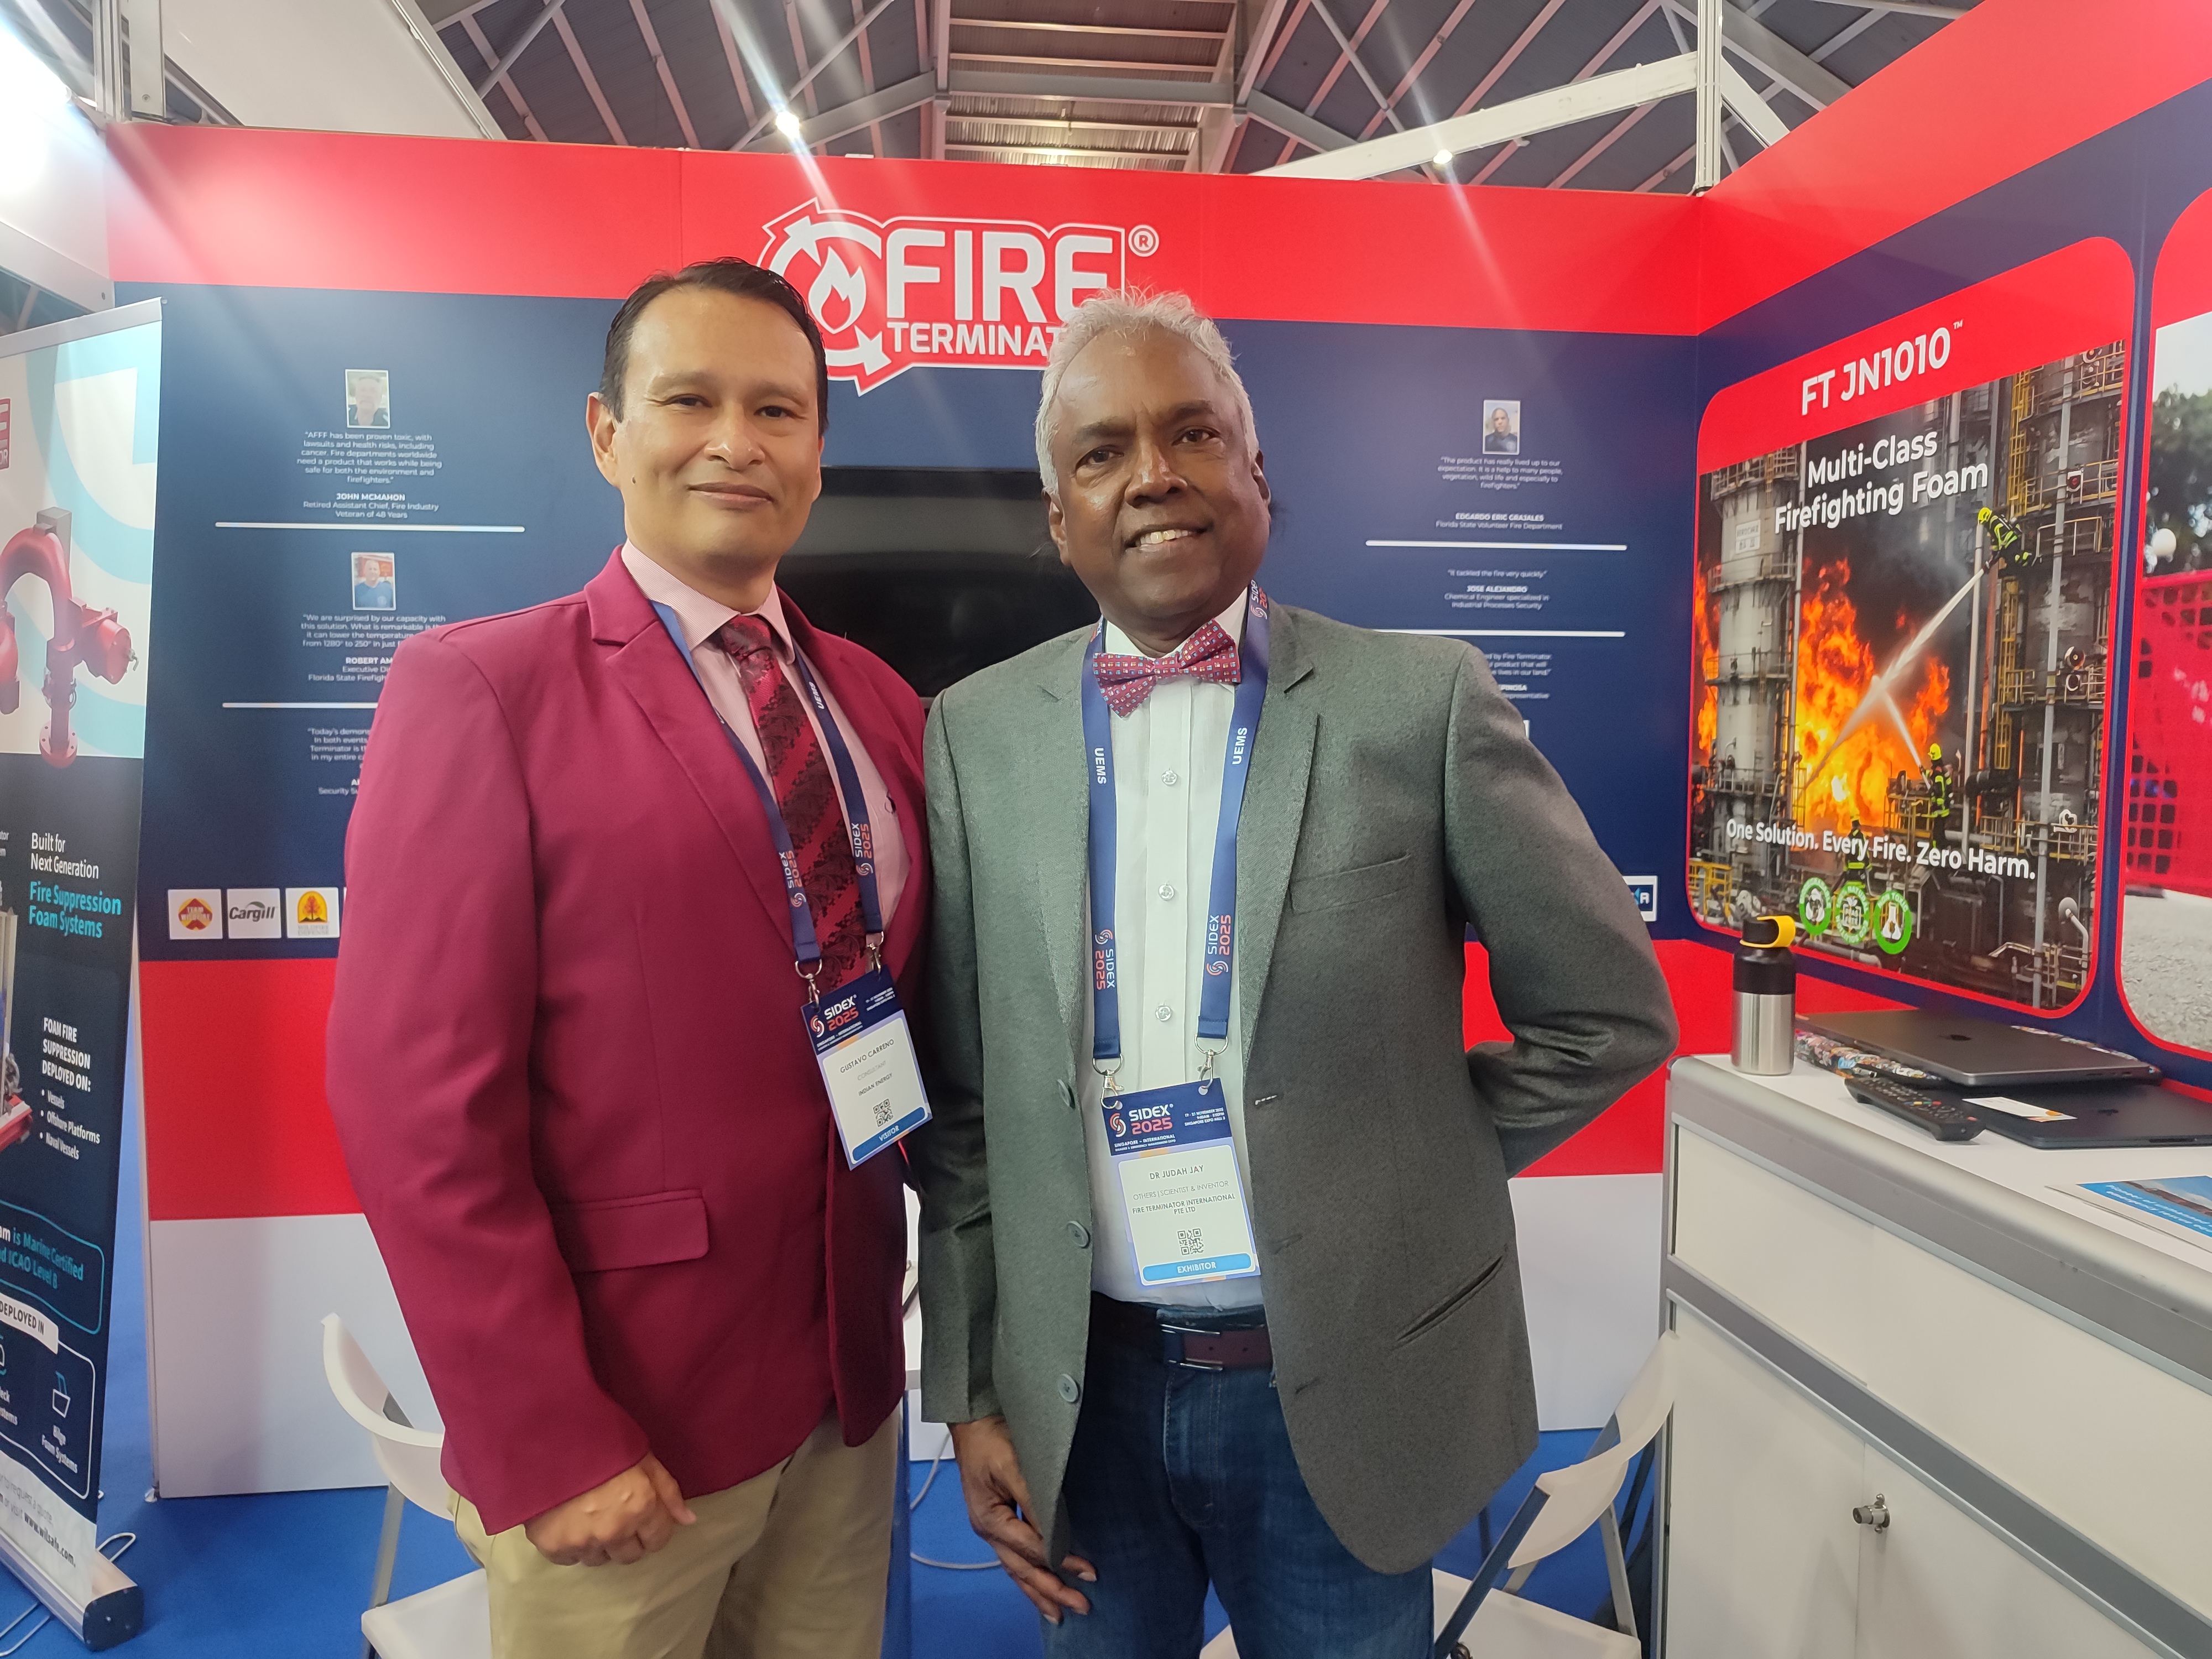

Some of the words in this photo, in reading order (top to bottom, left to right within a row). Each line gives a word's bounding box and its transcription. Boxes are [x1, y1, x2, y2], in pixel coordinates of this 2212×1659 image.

[886, 228, 1113, 322] FIRE
[1801, 369, 1836, 416] FT
[1840, 327, 1951, 402] JN1010
[399, 442, 434, 451] including
[1808, 430, 1938, 488] Multi-Class
[421, 460, 442, 469] being
[408, 503, 439, 512] Industry
[1774, 481, 1905, 534] Firefighting
[1912, 462, 1989, 504] Foam
[1476, 593, 1506, 602] Engineer
[1516, 602, 1543, 611] Security
[1232, 727, 1248, 765] UEMS
[1094, 748, 1107, 784] UEMS
[319, 787, 349, 795] Security
[32, 832, 54, 852] Built
[55, 833, 66, 853] for
[852, 823, 863, 857] SIDEX
[860, 823, 872, 859] 2025
[1726, 818, 1753, 842] One
[1756, 821, 1819, 851] Solution.
[1823, 833, 1869, 862] Every
[1872, 836, 1911, 863] Fire.
[1916, 841, 1963, 869] Zero
[1968, 849, 2036, 880] Harm.
[30, 852, 52, 872] Next
[54, 855, 99, 879] Generation
[779, 852, 795, 889] SIDEX
[786, 850, 802, 888] 2025
[30, 881, 51, 904] Fire
[54, 885, 121, 915] Suppression
[1891, 892, 1908, 912] TOXIC
[29, 905, 58, 929] Foam
[60, 910, 102, 938] Systems
[229, 906, 275, 922] Cargill
[1207, 915, 1219, 955] SIDEX
[1219, 915, 1231, 956] 2025
[1095, 950, 1105, 990] 2025
[1105, 948, 1115, 989] SIDEX
[824, 996, 855, 1020] SIDEX
[827, 1006, 859, 1031] 2025
[44, 1017, 61, 1037] FOAM
[62, 1023, 77, 1043] FIRE
[43, 1038, 91, 1070] SUPPRESSION
[840, 1053, 867, 1074] GUSTAVO
[868, 1039, 895, 1058] CARRENO
[41, 1060, 75, 1086] DEPLOYED
[75, 1073, 91, 1092] ON:
[857, 1061, 886, 1081] CONSULTANT
[858, 1082, 875, 1097] INDIAN
[875, 1072, 893, 1088] ENERGY
[47, 1089, 65, 1110] Vessels
[1129, 1104, 1171, 1121] SIDEX
[47, 1110, 67, 1132] Offshore
[67, 1121, 101, 1145] Platforms
[878, 1125, 900, 1142] VISITOR
[1131, 1117, 1173, 1135] 2025
[1143, 1134, 1176, 1143] INTERNATIONAL
[45, 1131, 60, 1154] Naval
[60, 1139, 80, 1161] Vessels
[1149, 1172, 1160, 1180] DR
[1162, 1167, 1188, 1178] JUDAH
[1190, 1165, 1204, 1173] JAY
[1132, 1206, 1145, 1214] FIRE
[1146, 1201, 1185, 1212] TERMINATOR
[1186, 1193, 1236, 1206] INTERNATIONAL
[1133, 1191, 1156, 1201] OTHERS
[1160, 1186, 1189, 1197] SCIENTIST
[1197, 1181, 1229, 1191] INVENTOR
[2106, 1191, 2158, 1211] emergency
[2158, 1211, 2193, 1224] rescue
[2154, 1203, 2210, 1224] unmanned
[13, 1227, 20, 1246] is
[23, 1232, 51, 1260] Marine
[51, 1248, 84, 1281] Certified
[8, 1249, 32, 1272] ICAO
[32, 1259, 52, 1286] Level
[1177, 1261, 1217, 1274] EXHIBITOR
[38, 1319, 44, 1336] IN
[56, 1447, 77, 1473] Systems
[11, 1483, 32, 1505] request
[11, 1503, 22, 1518] visit
